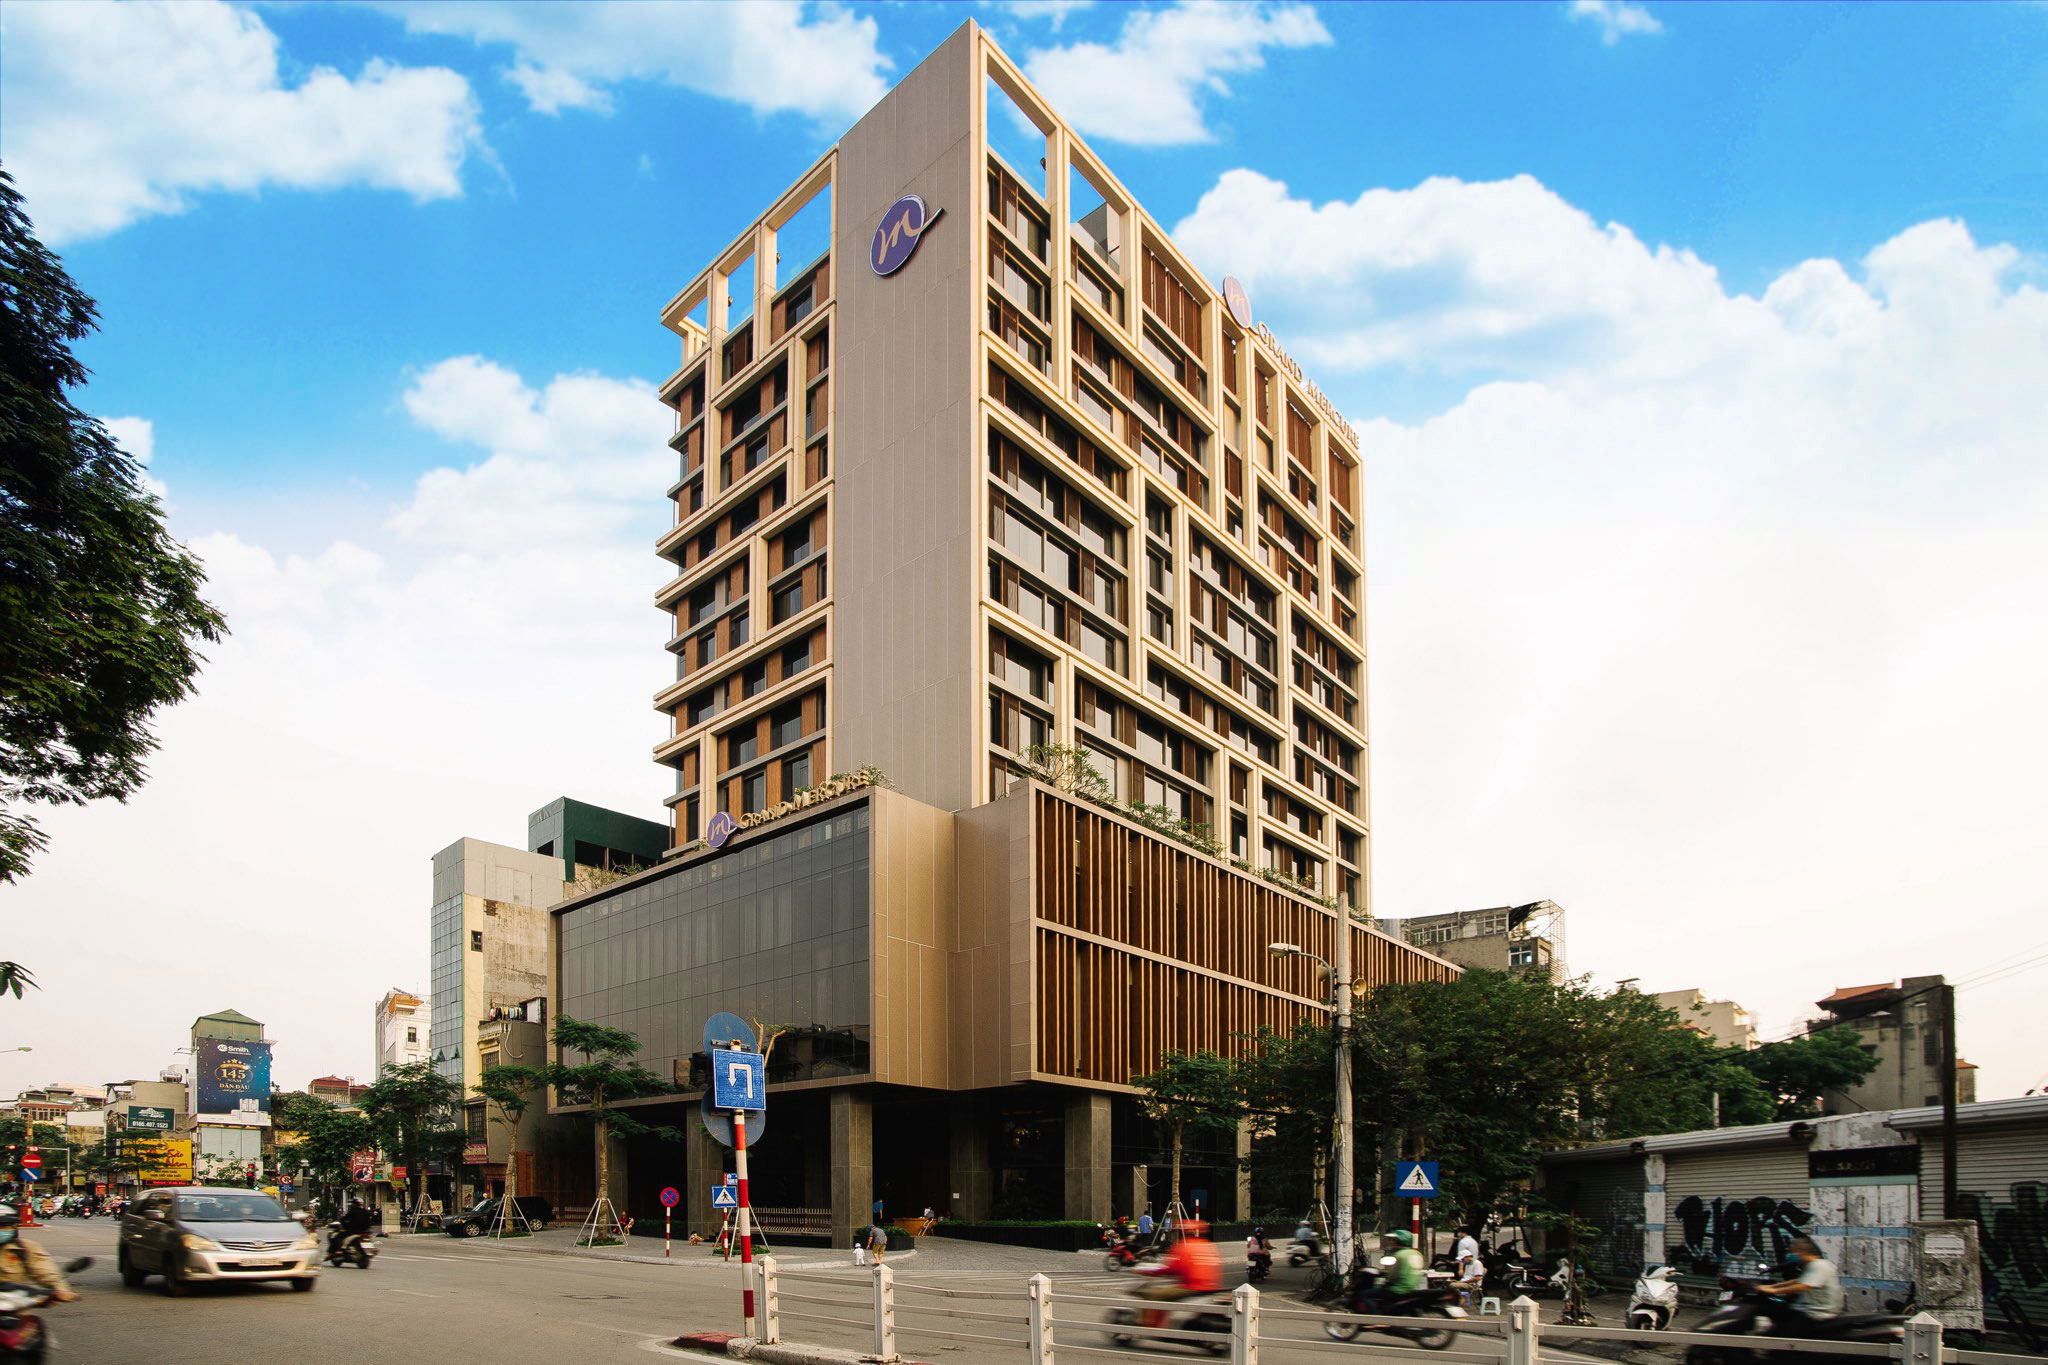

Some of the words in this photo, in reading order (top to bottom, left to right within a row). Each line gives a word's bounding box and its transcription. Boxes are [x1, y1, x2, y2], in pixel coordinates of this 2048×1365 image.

[1257, 320, 1303, 383] GRAND
[1306, 378, 1361, 450] MERCURE
[740, 801, 793, 829] GRAND
[793, 770, 870, 811] MERCURE
[221, 1068, 247, 1080] 145
